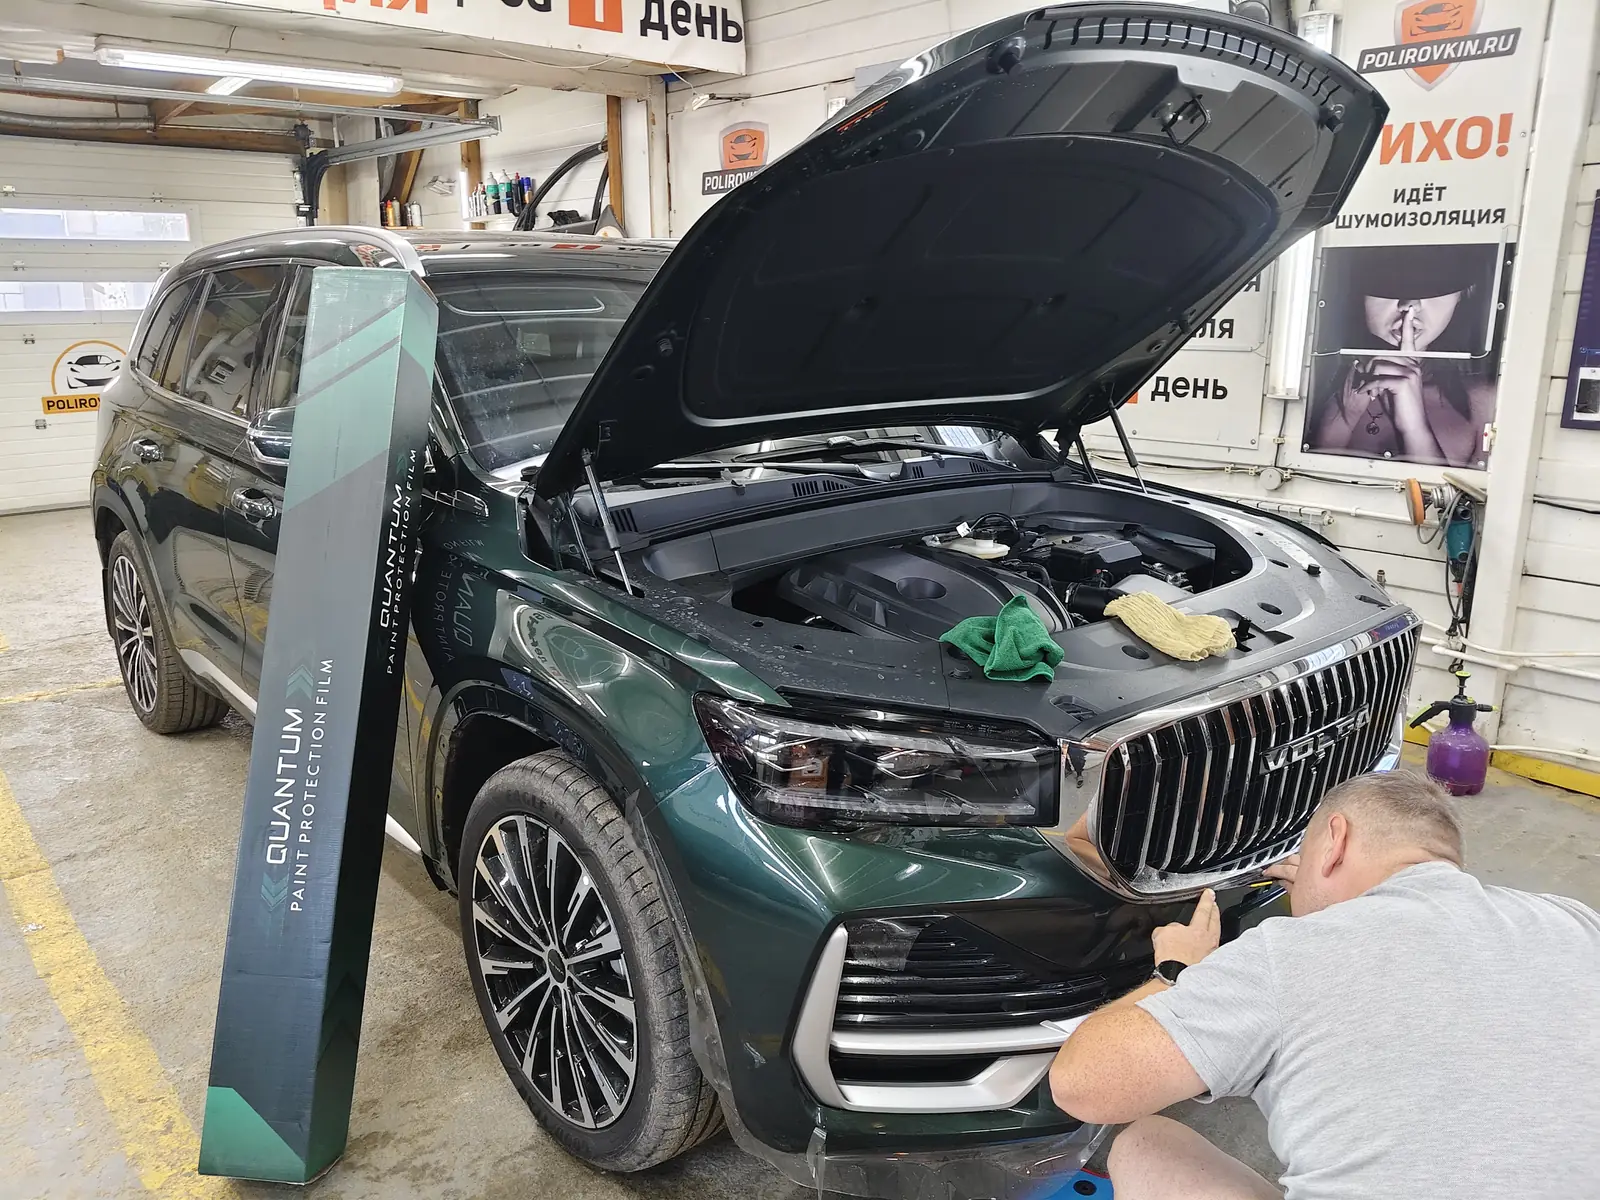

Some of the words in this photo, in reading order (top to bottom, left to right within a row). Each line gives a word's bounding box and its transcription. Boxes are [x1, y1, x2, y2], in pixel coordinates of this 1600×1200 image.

[640, 0, 743, 43] день
[1362, 33, 1514, 70] POLIROVKIN.RU
[1379, 112, 1514, 165] ИХО!
[704, 170, 757, 191] POLIROV
[1393, 182, 1447, 205] ИДЁТ
[1335, 208, 1506, 229] ШУМОИЗОЛЯЦИЯ
[1150, 376, 1228, 402] день
[380, 483, 403, 628] QUANTUM
[386, 620, 399, 674] PAINT
[393, 495, 411, 613] PROTECTION
[406, 449, 417, 490] FILM
[316, 659, 334, 705] FILM
[266, 707, 304, 865] QUANTUM
[299, 711, 328, 843] PROTECTION
[290, 849, 309, 911] PAINT
